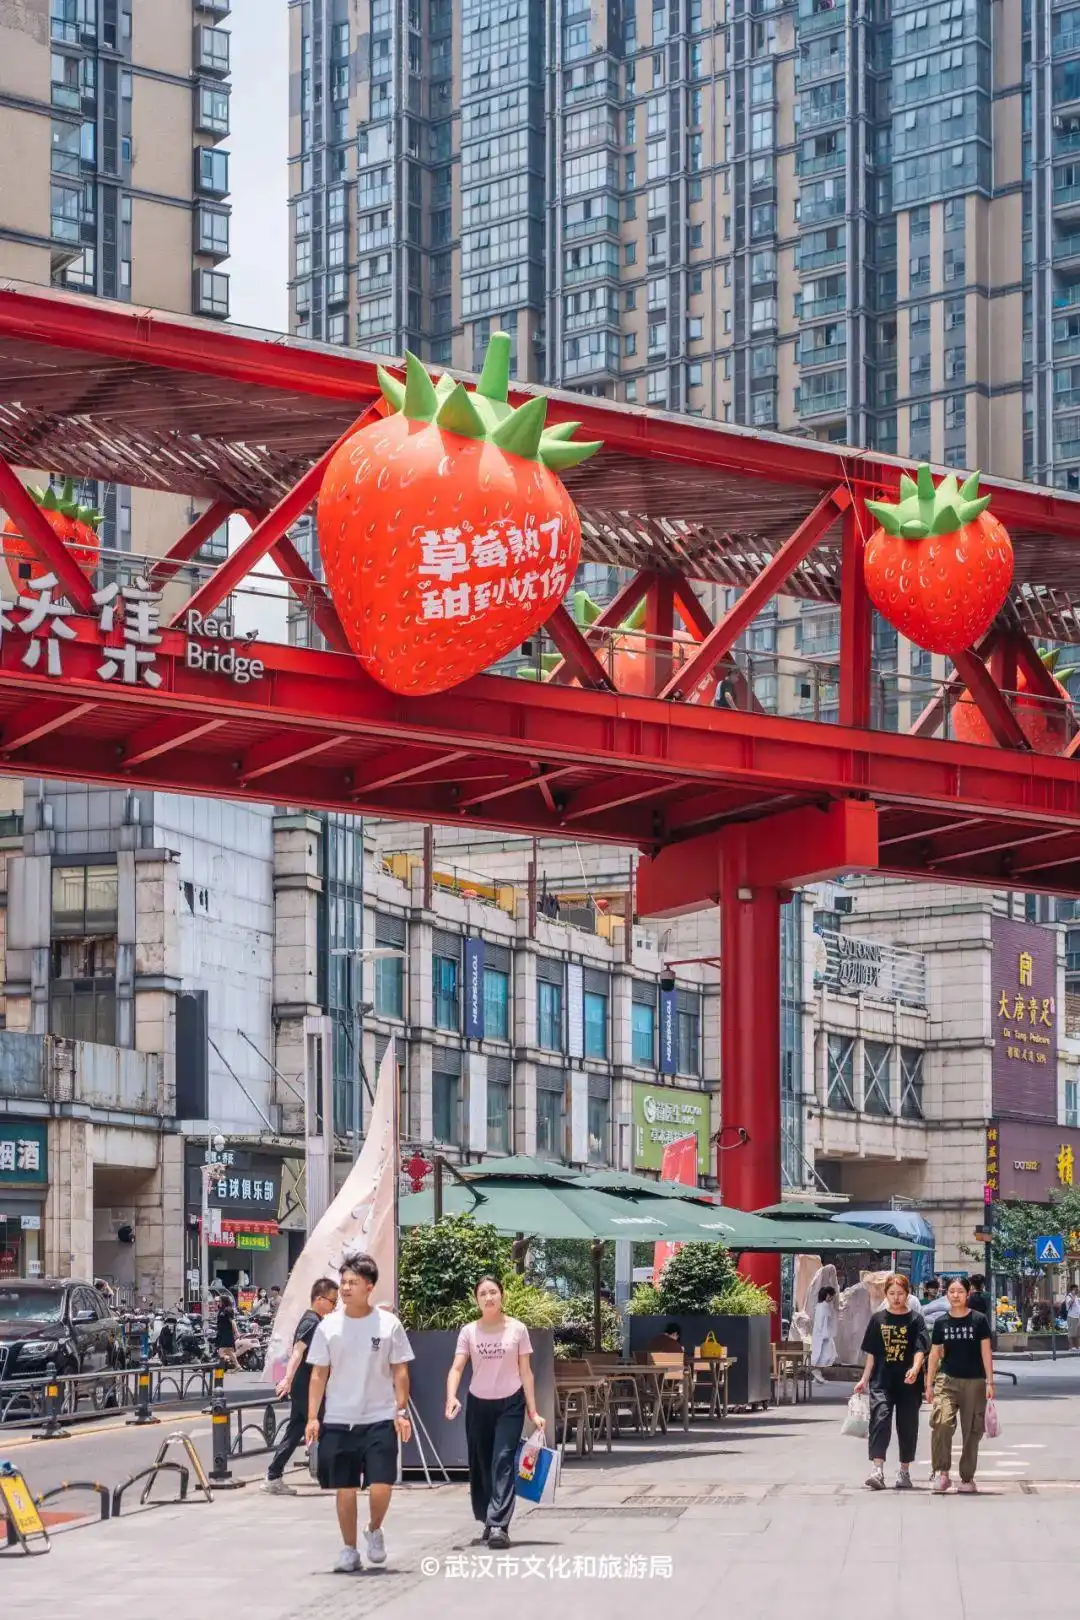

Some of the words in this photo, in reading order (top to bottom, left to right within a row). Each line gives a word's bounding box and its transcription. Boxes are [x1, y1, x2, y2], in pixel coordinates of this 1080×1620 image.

[418, 518, 561, 581] 草莓熟了
[421, 562, 567, 620] 甜到忧伤
[188, 608, 235, 641] Red
[187, 641, 265, 684] Bridge
[998, 990, 1053, 1027] 大唐贵足
[217, 1178, 275, 1201] 台球俱乐部
